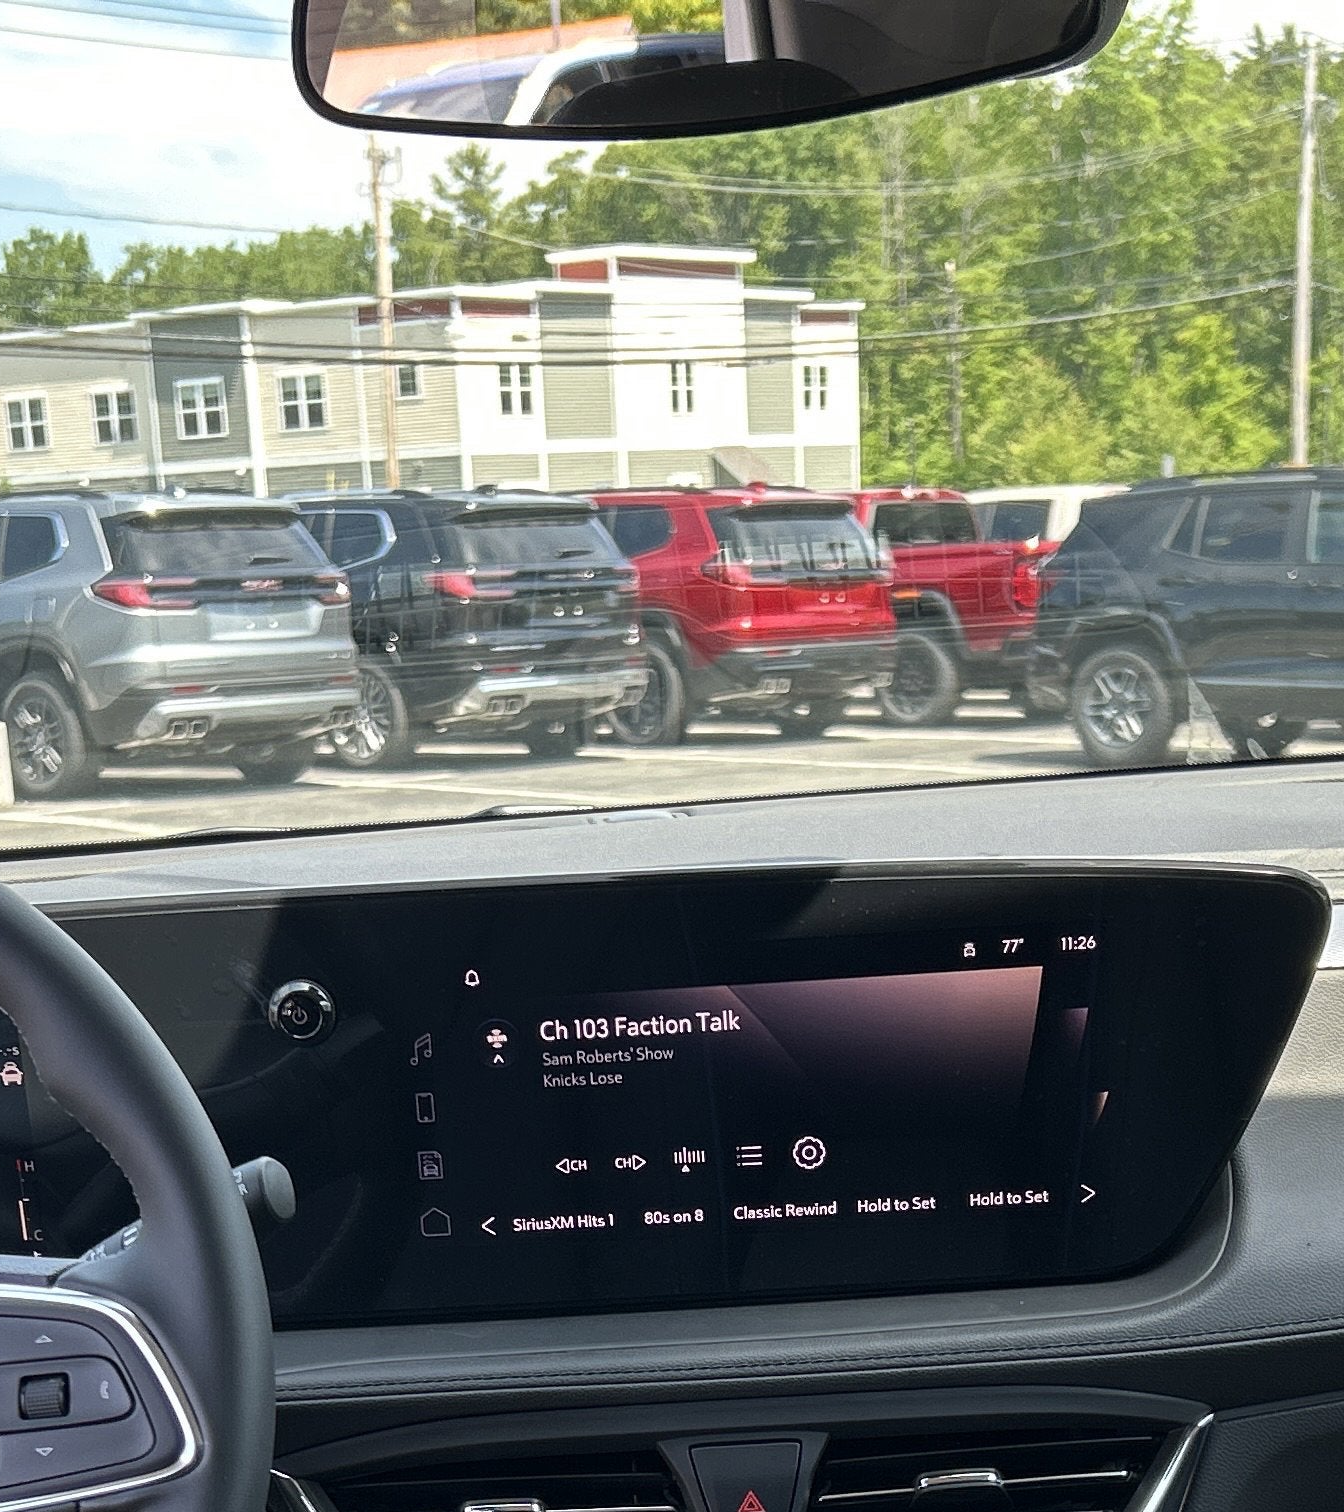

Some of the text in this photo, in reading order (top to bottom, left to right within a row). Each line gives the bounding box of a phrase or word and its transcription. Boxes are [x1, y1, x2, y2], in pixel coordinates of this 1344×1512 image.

[1001, 938, 1025, 954] 77°
[1060, 935, 1097, 951] 11:26
[539, 1009, 742, 1042] Ch 103 Faction Talk
[542, 1046, 675, 1067] Sam Roberts' Show
[542, 1071, 623, 1088] Knicks Lose
[24, 1160, 35, 1172] H
[570, 1159, 588, 1171] CH
[614, 1157, 632, 1169] CH
[857, 1196, 936, 1214] Hold to Set
[969, 1190, 1049, 1207] Hold to Set
[644, 1209, 704, 1225] 80s on 8
[733, 1201, 837, 1220] Classic Rewind
[512, 1213, 614, 1232] SiriusXM Hits 1
[33, 1229, 44, 1242] C
